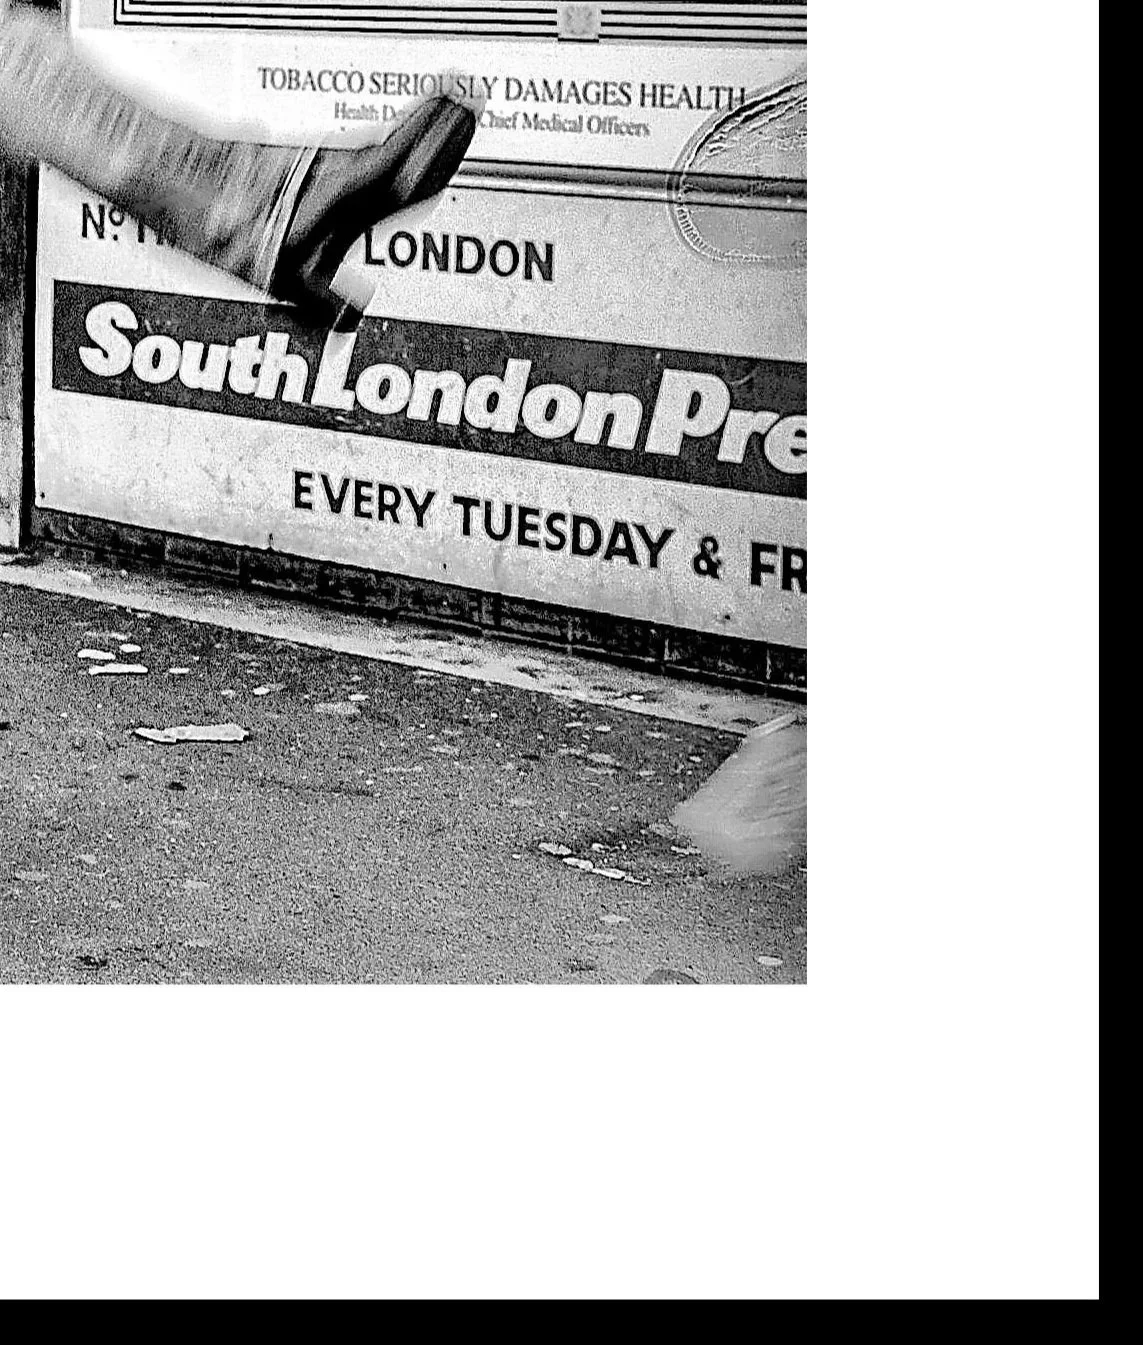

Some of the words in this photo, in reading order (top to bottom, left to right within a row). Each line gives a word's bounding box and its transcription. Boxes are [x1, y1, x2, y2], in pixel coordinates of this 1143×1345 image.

[258, 66, 366, 94] TOBACCO
[369, 71, 499, 101] SERIOUSLY
[505, 77, 632, 107] DAMAGES
[639, 83, 746, 112] HEALTH
[522, 112, 584, 134] Medical
[587, 115, 651, 138] Officers
[364, 230, 555, 281] LONDON
[78, 301, 309, 404] South
[310, 331, 644, 451] London
[645, 368, 807, 474] Pre
[292, 471, 436, 528] EVERY
[452, 495, 676, 570] TUESDAY
[693, 536, 722, 580] &
